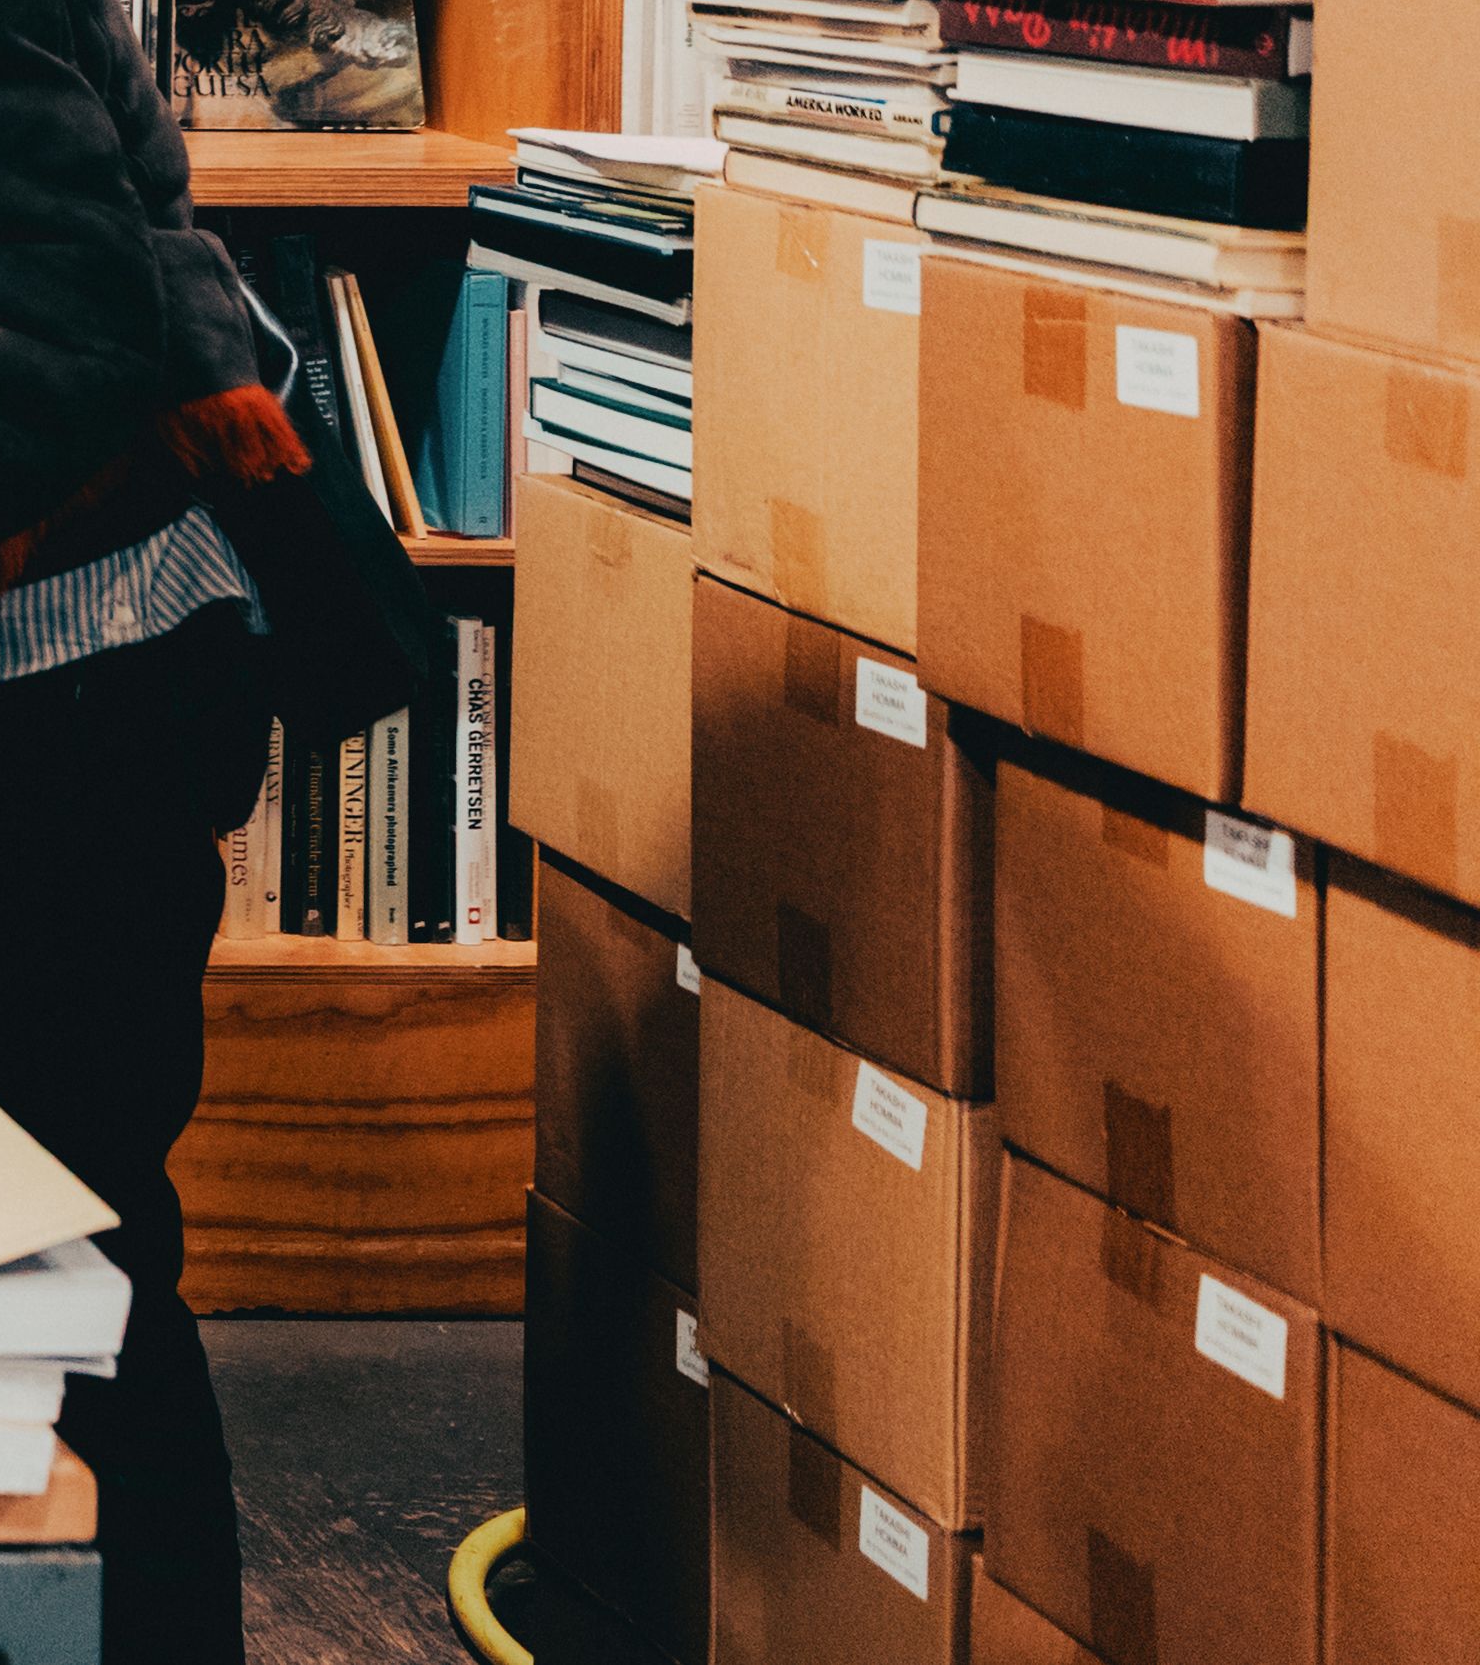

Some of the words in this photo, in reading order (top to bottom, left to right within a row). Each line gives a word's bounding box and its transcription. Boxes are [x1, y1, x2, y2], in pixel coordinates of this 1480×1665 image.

[468, 679, 483, 724] CHAS
[387, 727, 398, 754] Some
[386, 758, 398, 811] Afrikaners
[467, 730, 483, 830] GERRETSEN
[384, 814, 398, 887] photographed
